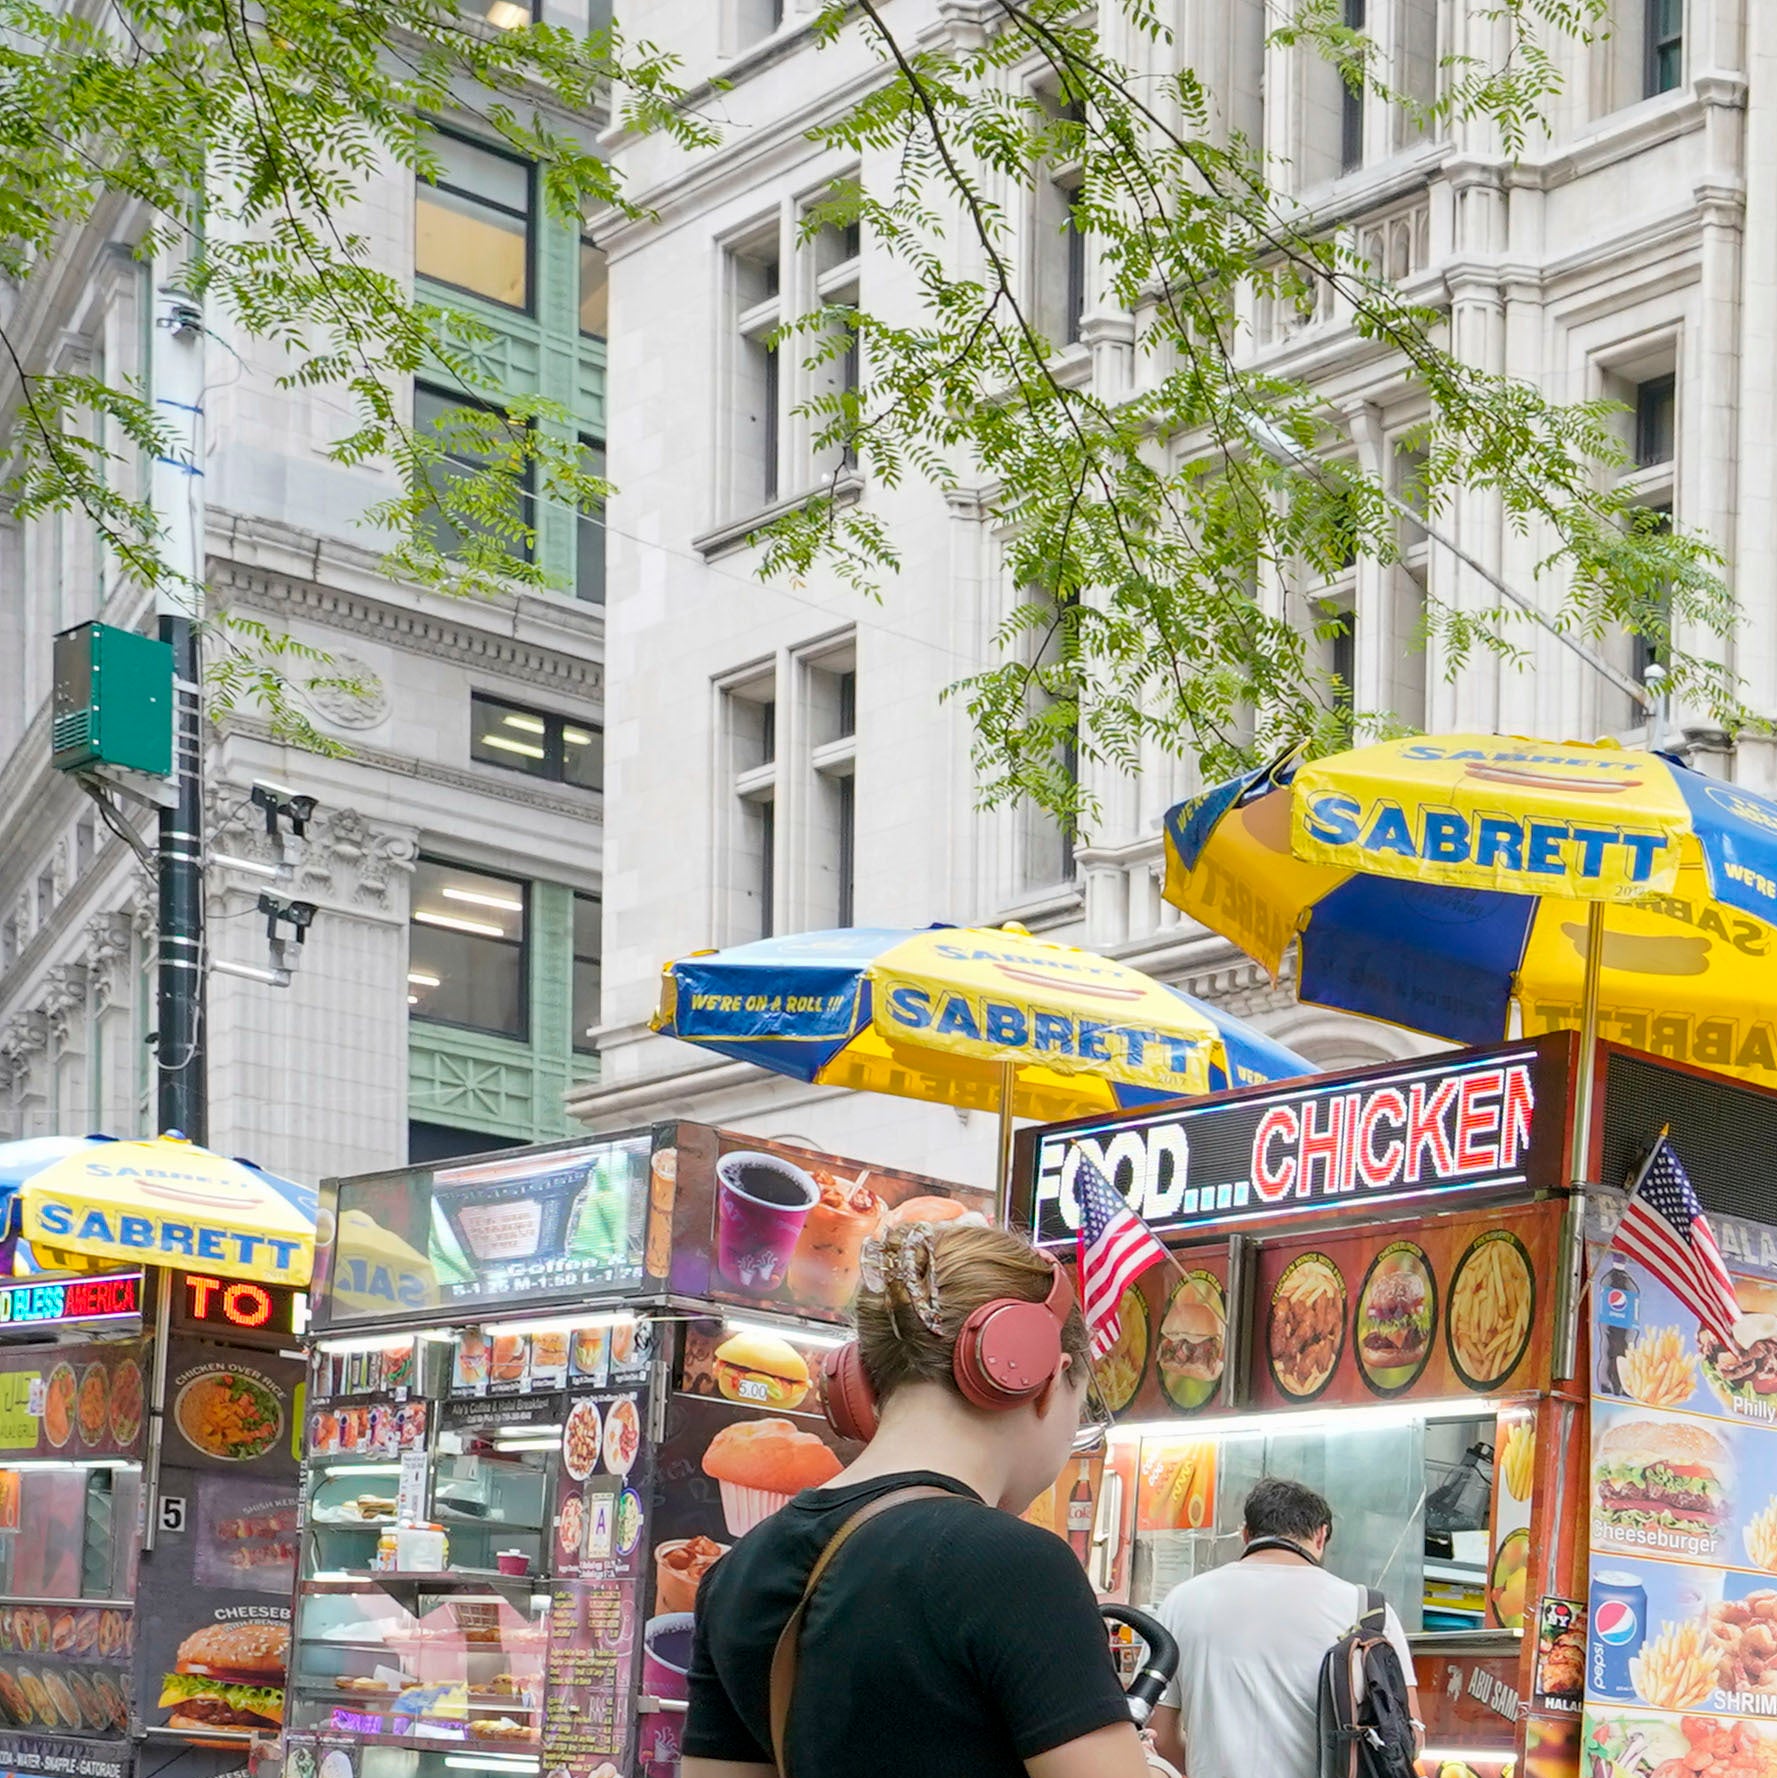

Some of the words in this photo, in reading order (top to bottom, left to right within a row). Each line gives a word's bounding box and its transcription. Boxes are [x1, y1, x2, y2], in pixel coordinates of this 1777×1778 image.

[1402, 745, 1643, 771] SABRETT
[1304, 792, 1668, 882] SABRETT
[1724, 862, 1776, 898] WE'RE
[936, 944, 1124, 978] SABRETT
[692, 994, 741, 1012] WE'RE
[745, 995, 766, 1012] ON
[769, 996, 781, 1011] A
[785, 996, 823, 1013] ROLL
[886, 982, 1199, 1073] SABRETT
[1251, 1066, 1535, 1202] CHICKEN
[38, 1202, 301, 1269] SABRETT
[12, 1286, 64, 1321] BLESS
[64, 1280, 135, 1316] AMERICA
[186, 1275, 273, 1327] TO
[175, 1362, 225, 1386] CHICKEN
[228, 1363, 262, 1379] OVER
[738, 1382, 768, 1399] 5.00
[1732, 1395, 1776, 1422] Philly
[163, 1498, 182, 1529] 5
[1467, 1666, 1494, 1704] ABU
[1594, 1643, 1607, 1690] pepsi
